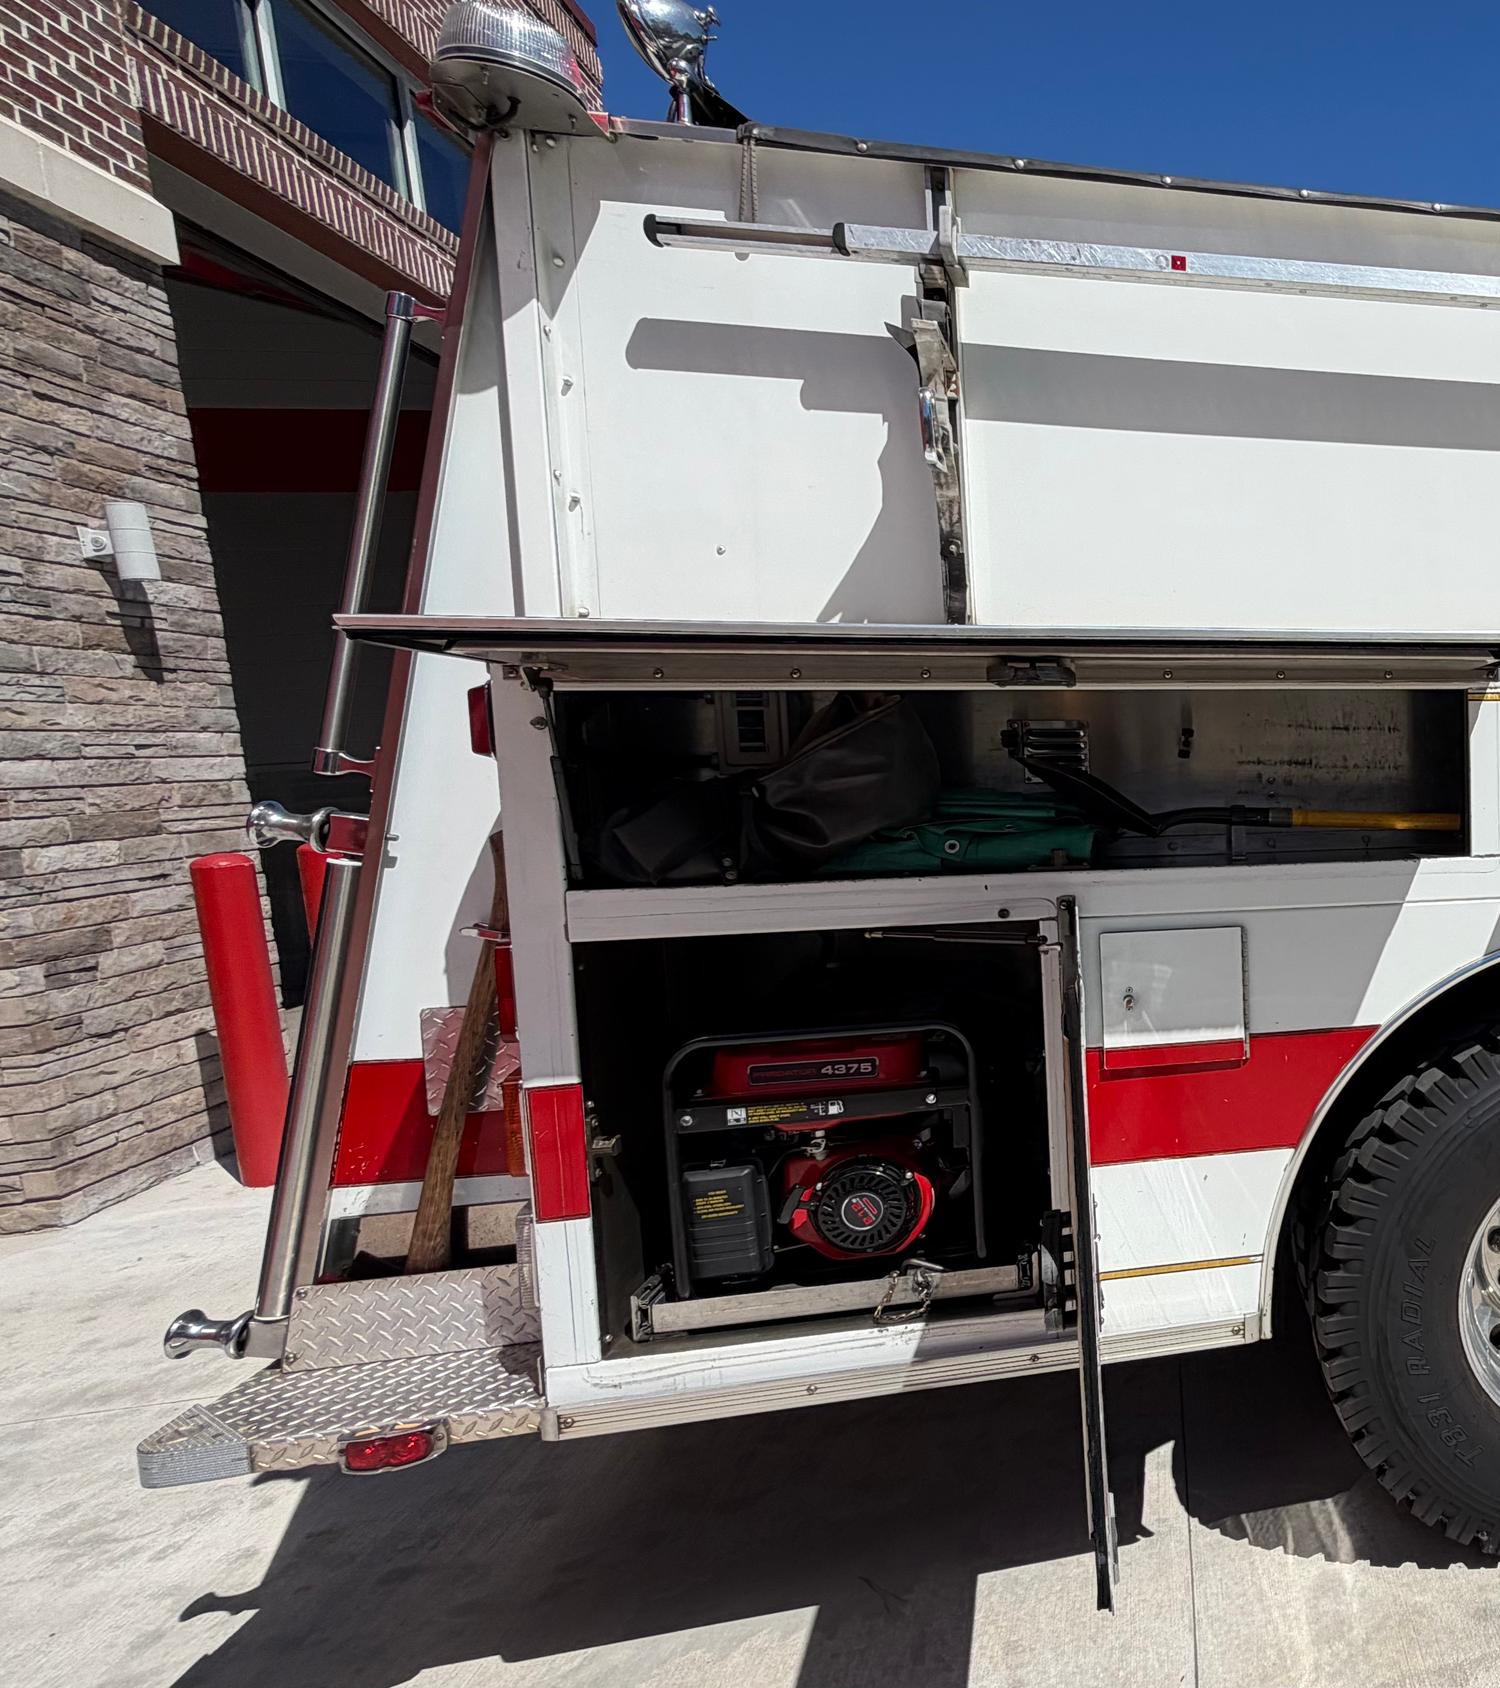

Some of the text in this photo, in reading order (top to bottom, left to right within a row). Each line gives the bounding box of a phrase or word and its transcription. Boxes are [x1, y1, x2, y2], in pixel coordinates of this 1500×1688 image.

[820, 1062, 873, 1076] 4375
[1400, 1237, 1487, 1469] T831 RADIAL
